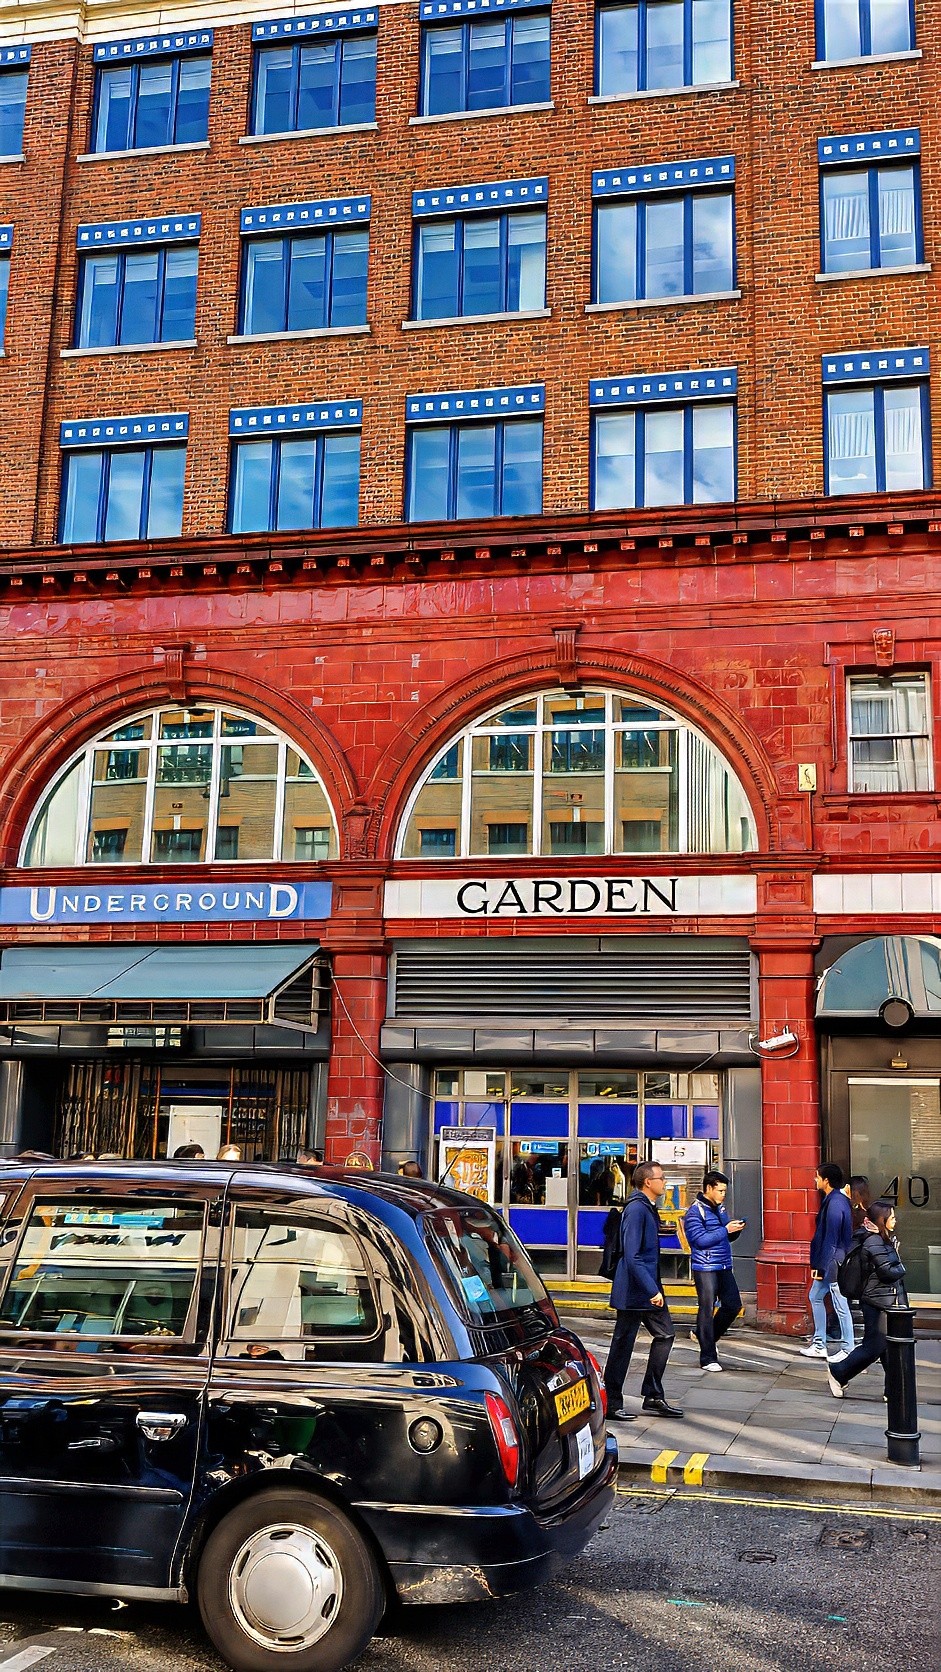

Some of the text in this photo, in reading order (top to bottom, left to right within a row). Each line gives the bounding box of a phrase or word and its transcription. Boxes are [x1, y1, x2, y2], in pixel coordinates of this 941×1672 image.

[29, 883, 298, 921] UNDERGROUND
[457, 878, 679, 914] GARDEN
[880, 1176, 930, 1208] 40
